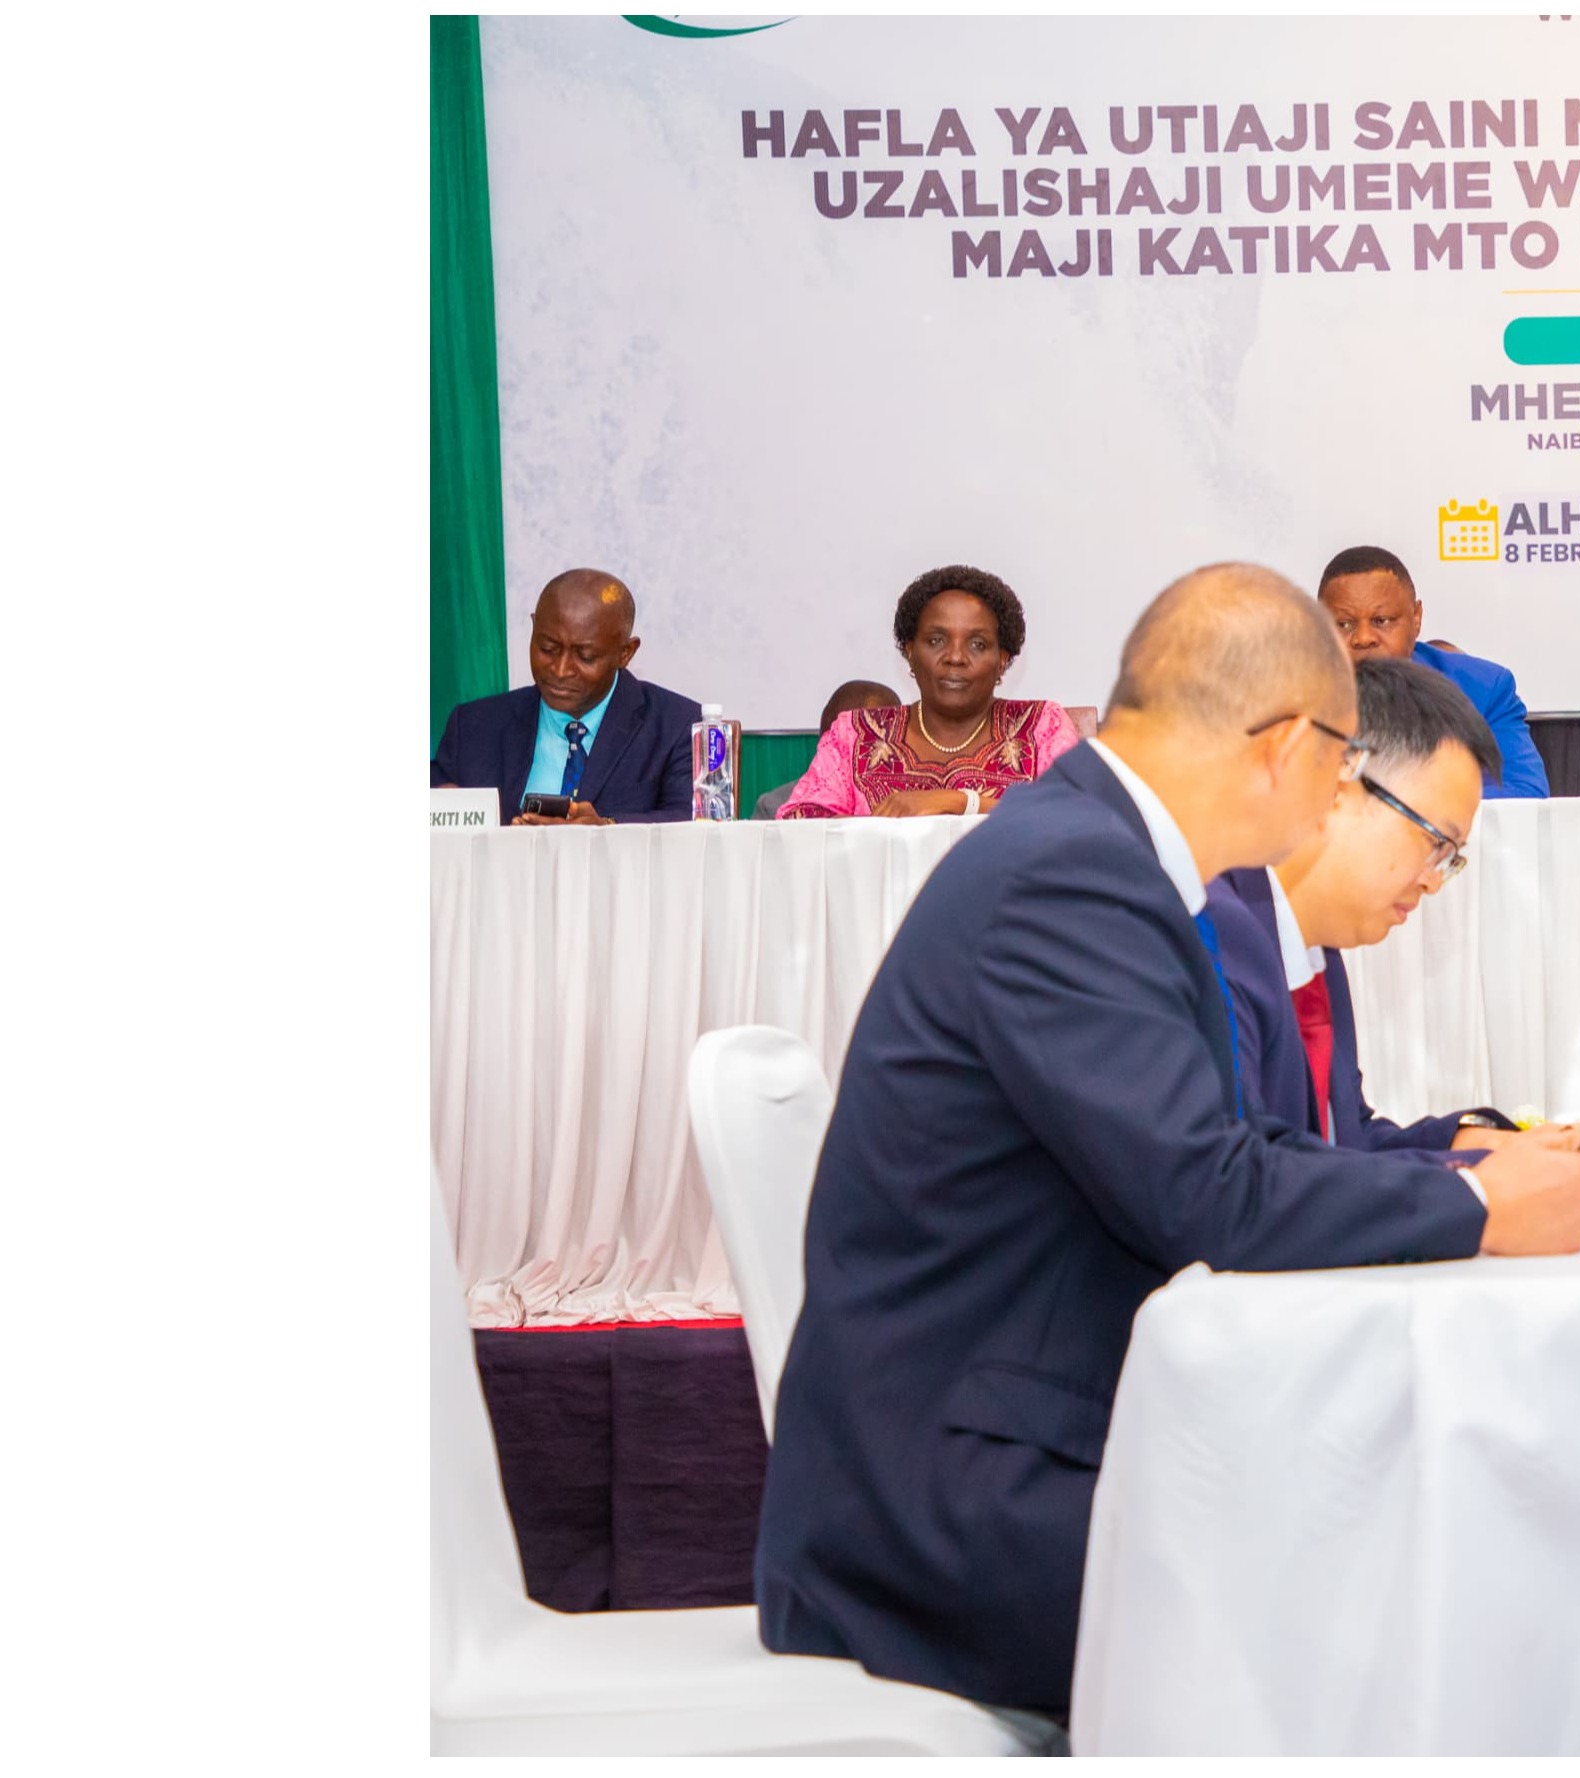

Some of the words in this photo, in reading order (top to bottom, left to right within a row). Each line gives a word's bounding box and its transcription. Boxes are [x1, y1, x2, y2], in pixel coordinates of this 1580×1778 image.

[742, 109, 976, 158] HAFLA
[995, 107, 1087, 155] YA
[1109, 103, 1329, 155] UTIAJI
[1354, 99, 1538, 150] SAINI
[814, 167, 1221, 219] UZALISHAJI
[1247, 161, 1492, 213] UMEME
[952, 229, 1112, 278] MAJI
[1139, 224, 1390, 276] KATIKA
[1414, 221, 1559, 270] MTO
[1505, 543, 1519, 563] 8
[430, 812, 459, 826] KITI
[464, 812, 485, 825] KN
